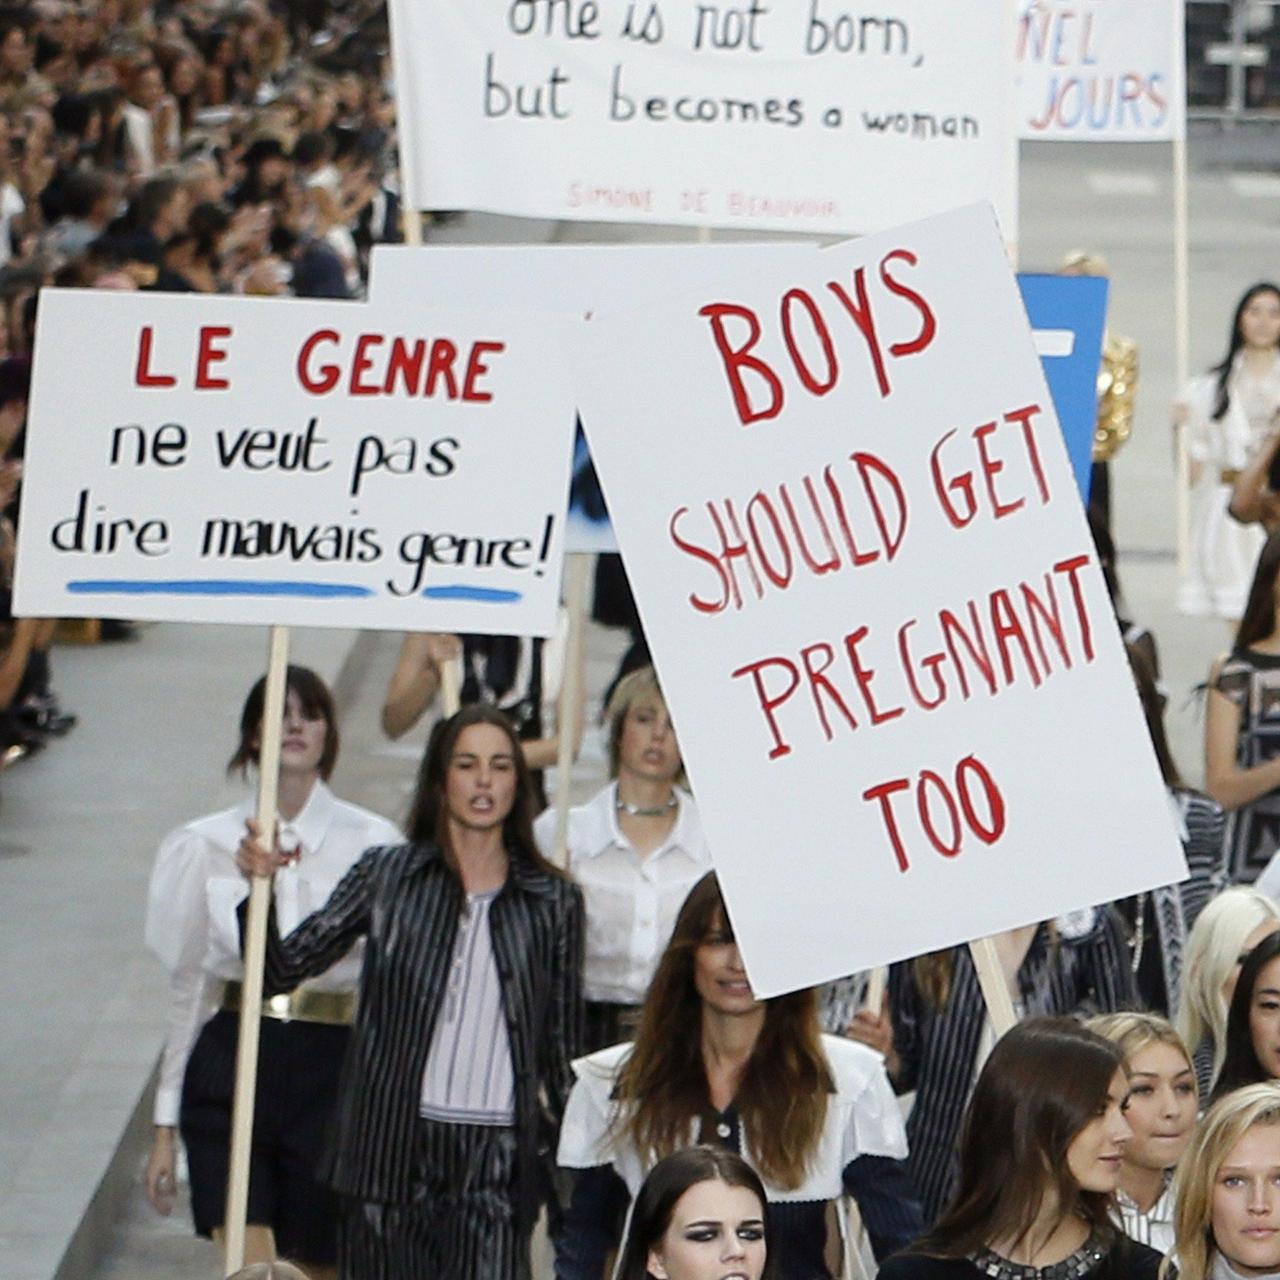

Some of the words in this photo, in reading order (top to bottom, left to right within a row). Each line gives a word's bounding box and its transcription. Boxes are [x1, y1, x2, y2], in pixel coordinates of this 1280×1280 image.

[620, 0, 664, 44] is
[693, 0, 770, 51] not
[805, 5, 926, 68] born,
[484, 52, 571, 119] but
[609, 63, 802, 126] becomes
[823, 106, 843, 129] a
[862, 108, 981, 141] woman
[1028, 72, 1167, 130] JOURS
[135, 326, 233, 390] LE
[297, 329, 506, 403] GENRE
[698, 248, 939, 426] BOYS
[110, 422, 187, 467] ne
[215, 417, 333, 473] veut
[350, 435, 459, 497] pas
[50, 489, 169, 556] dire
[201, 510, 382, 563] mauvais
[386, 514, 555, 597] genre!
[669, 451, 908, 615] SHOULD
[930, 404, 1052, 528] GET
[731, 554, 1097, 760] PREGNANT
[863, 753, 1008, 873] TOO
